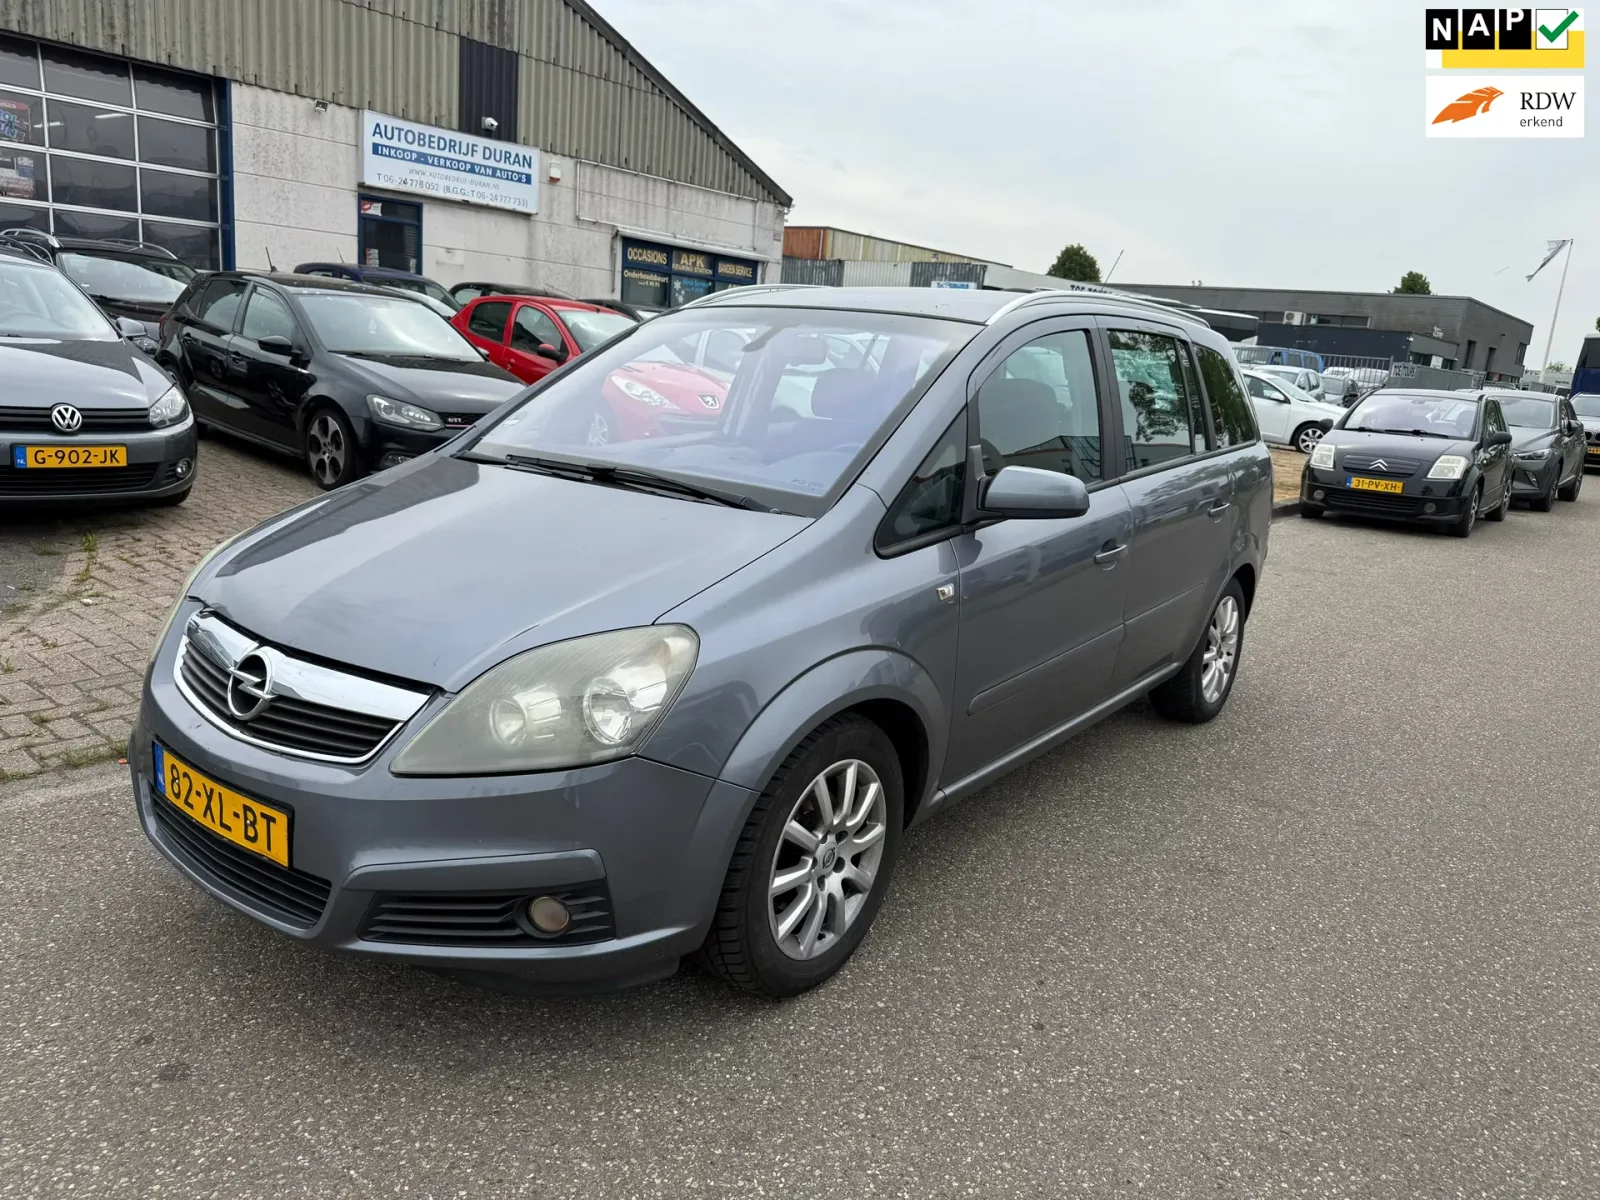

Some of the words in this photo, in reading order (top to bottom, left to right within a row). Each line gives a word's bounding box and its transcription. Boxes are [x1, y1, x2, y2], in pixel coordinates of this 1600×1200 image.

[372, 123, 478, 157] AUTOBEDRIJF
[482, 145, 532, 169] DURAN
[378, 145, 417, 161] INKOOP
[427, 155, 471, 172] VERKOOP
[474, 164, 493, 176] VAN
[495, 170, 527, 183] AUTO'S
[376, 172, 382, 181] T
[470, 189, 475, 197] T
[627, 247, 668, 265] OCCASIONS
[680, 252, 705, 268] APK
[694, 266, 713, 275] STATION
[34, 449, 120, 464] G-902-JK
[1354, 479, 1398, 492] 31-PV-XH
[170, 763, 277, 852] 82-XL-BT
